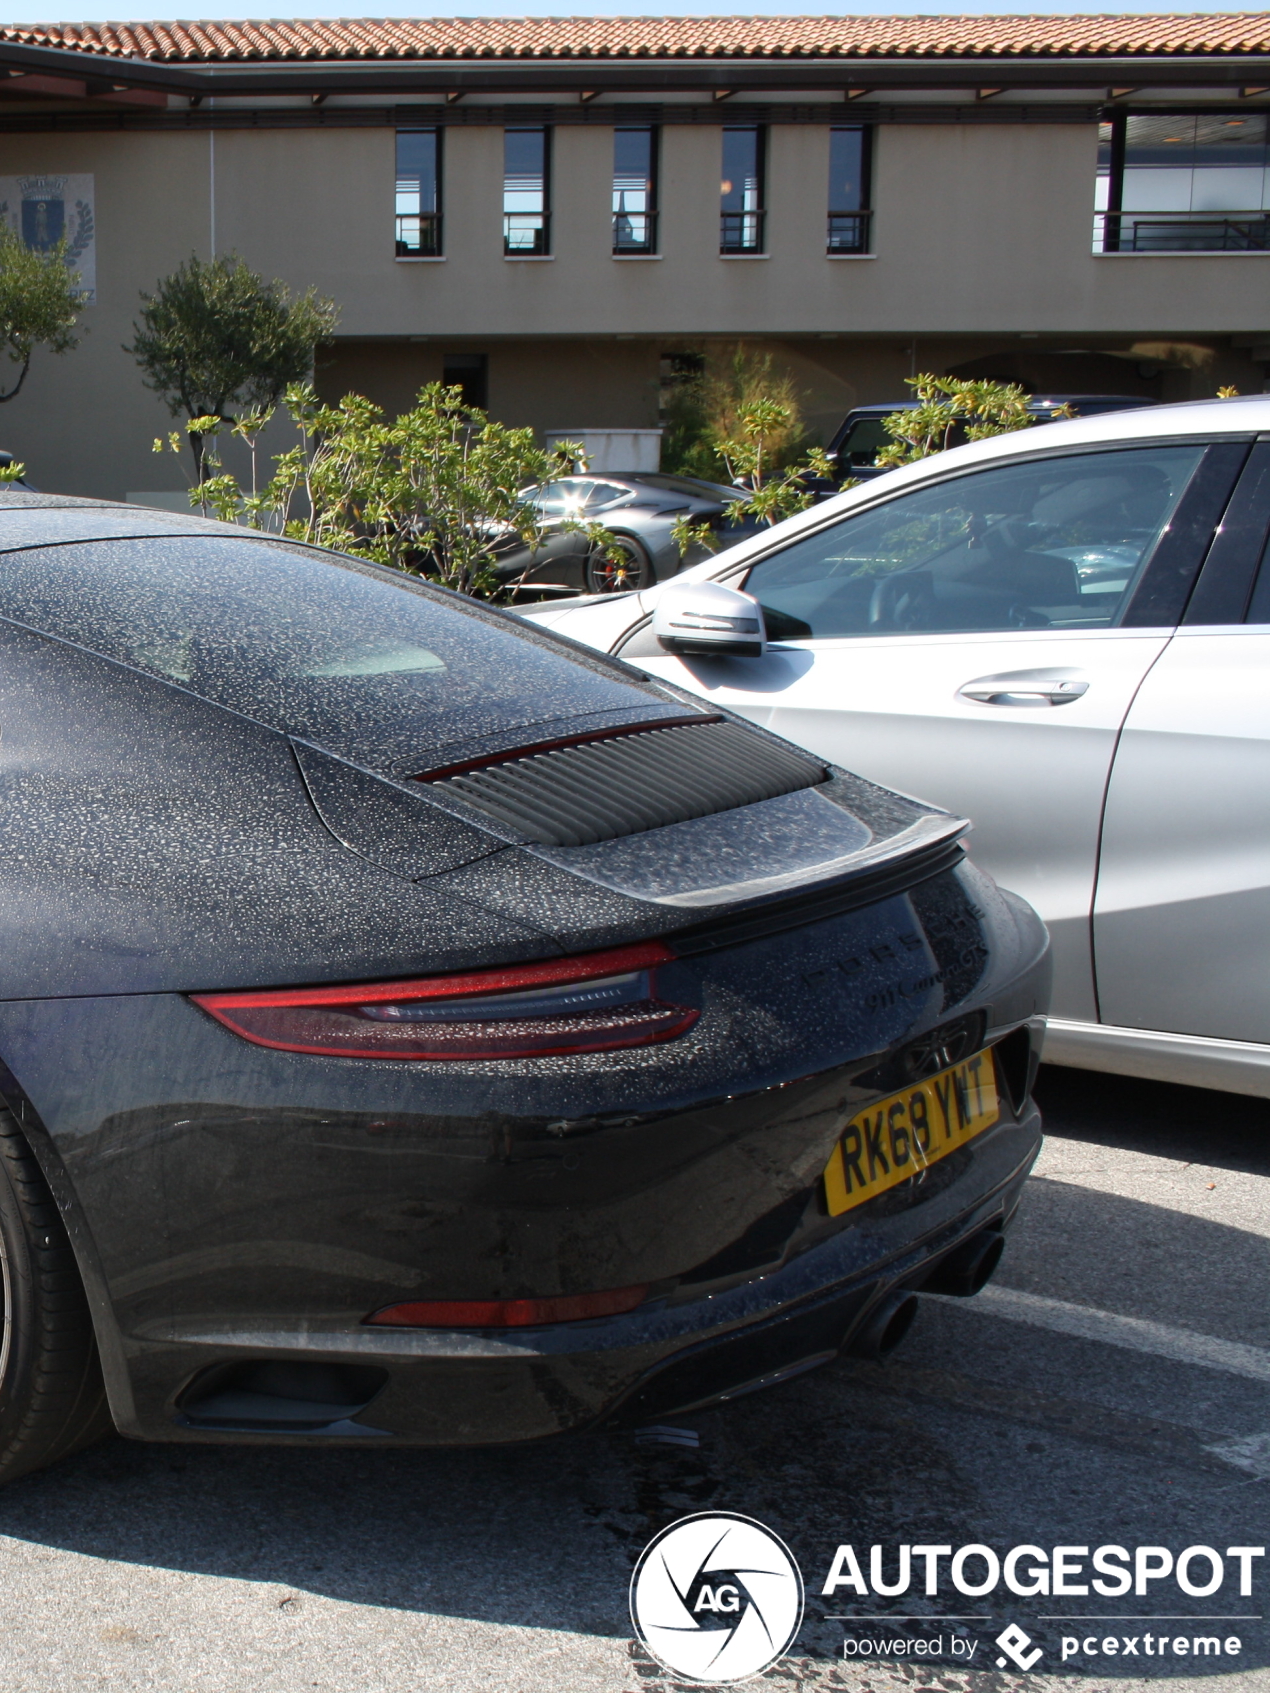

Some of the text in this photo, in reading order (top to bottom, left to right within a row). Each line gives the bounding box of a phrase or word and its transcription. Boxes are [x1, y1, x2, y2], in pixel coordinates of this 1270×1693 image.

[801, 902, 986, 988] PORSCHE
[865, 943, 989, 1014] 911 Carrera GTS
[840, 1091, 930, 1195] RK68
